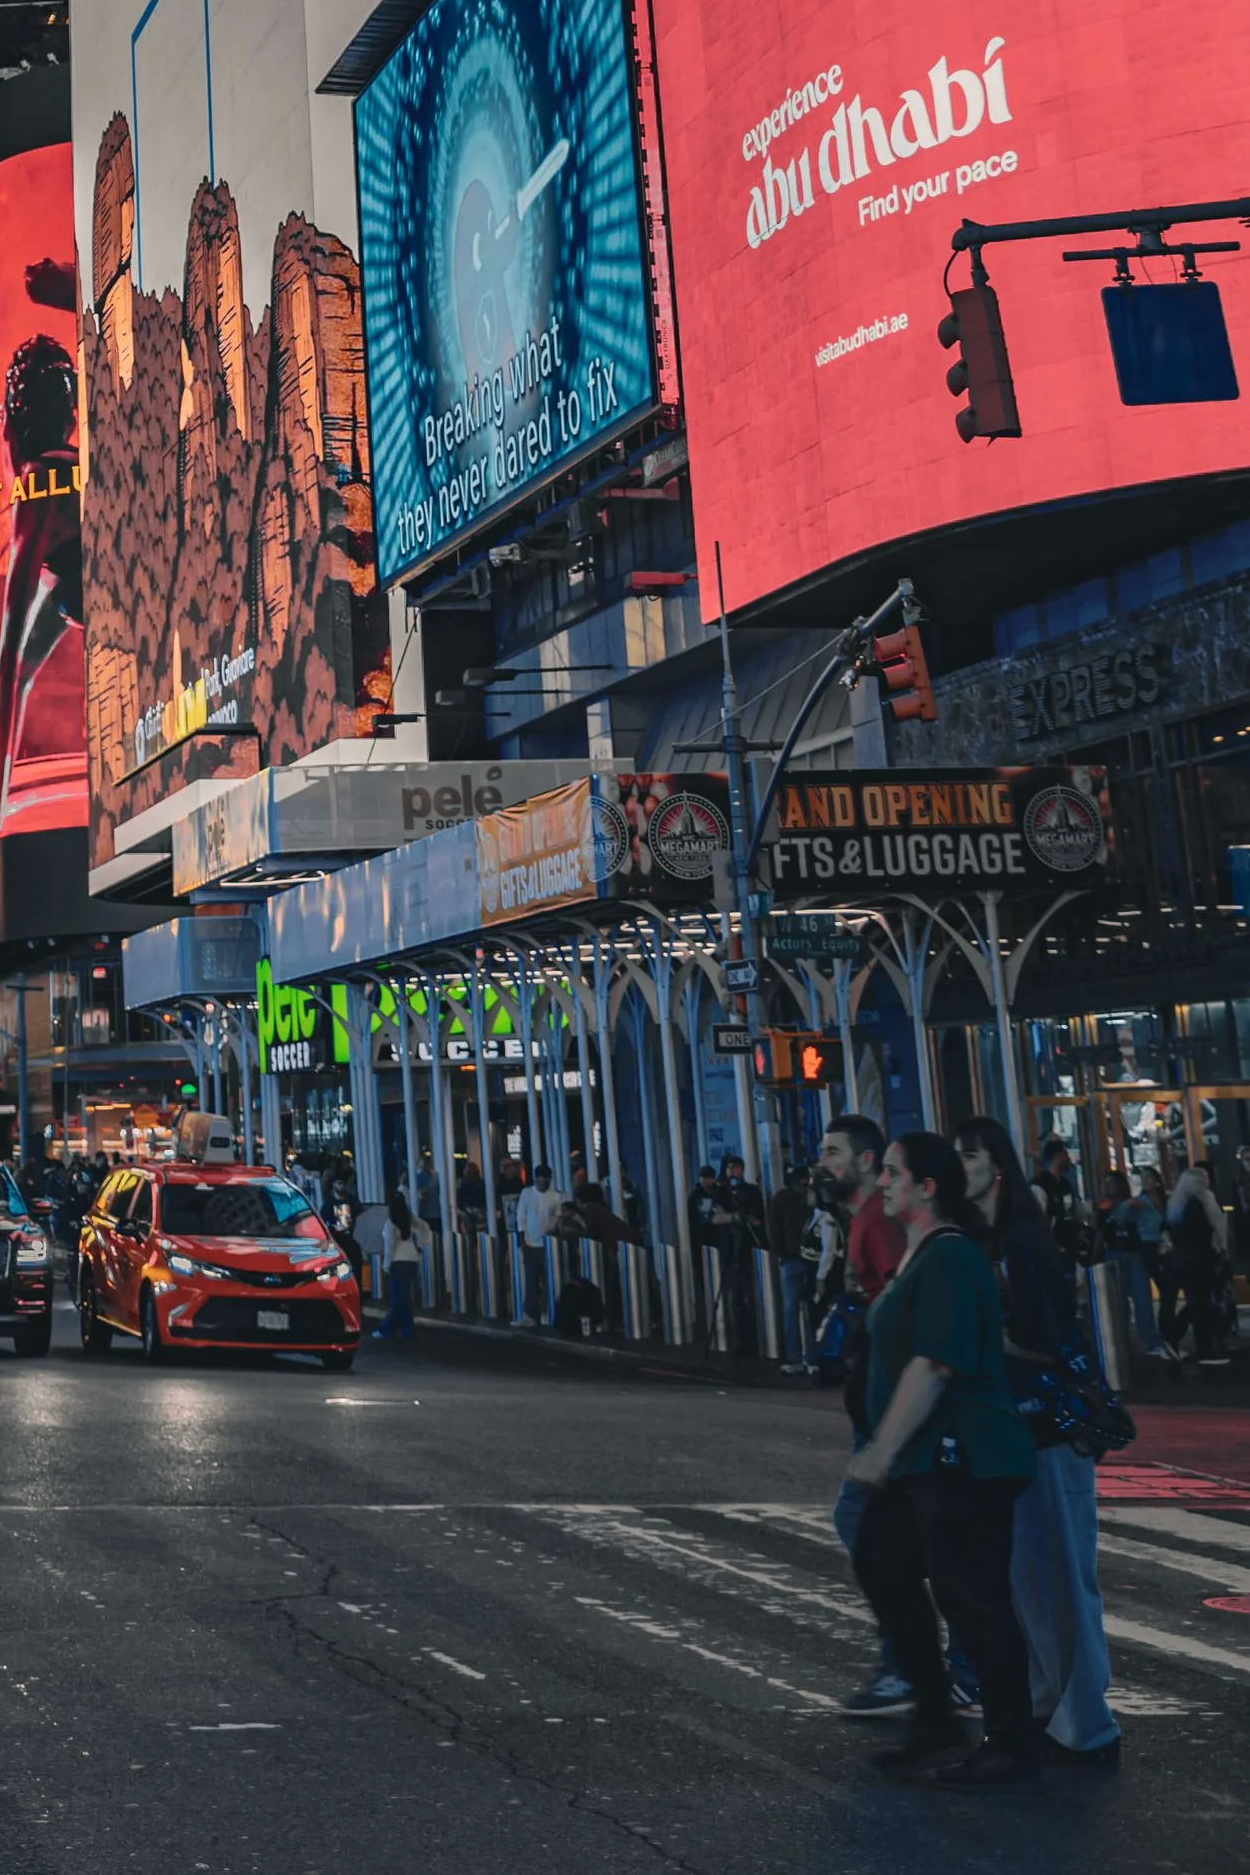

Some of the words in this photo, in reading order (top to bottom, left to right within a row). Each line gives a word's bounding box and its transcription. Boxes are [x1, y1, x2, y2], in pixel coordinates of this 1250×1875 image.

[745, 146, 815, 249] abu
[856, 184, 900, 227] Find
[901, 169, 951, 215] your
[954, 149, 1020, 195] pace
[814, 312, 910, 367] visitabudhabi.ae
[423, 368, 506, 468] Breaking
[508, 314, 563, 401] what
[397, 495, 435, 555] they
[437, 455, 488, 527] never
[495, 395, 553, 488] dared
[556, 389, 581, 443] to
[586, 356, 619, 423] fix
[1007, 641, 1162, 742] EXPRESS
[861, 781, 1014, 827] OPENING
[660, 840, 721, 855] MEGAMART
[821, 938, 861, 954] Equity
[270, 1040, 311, 1073] SOCCER
